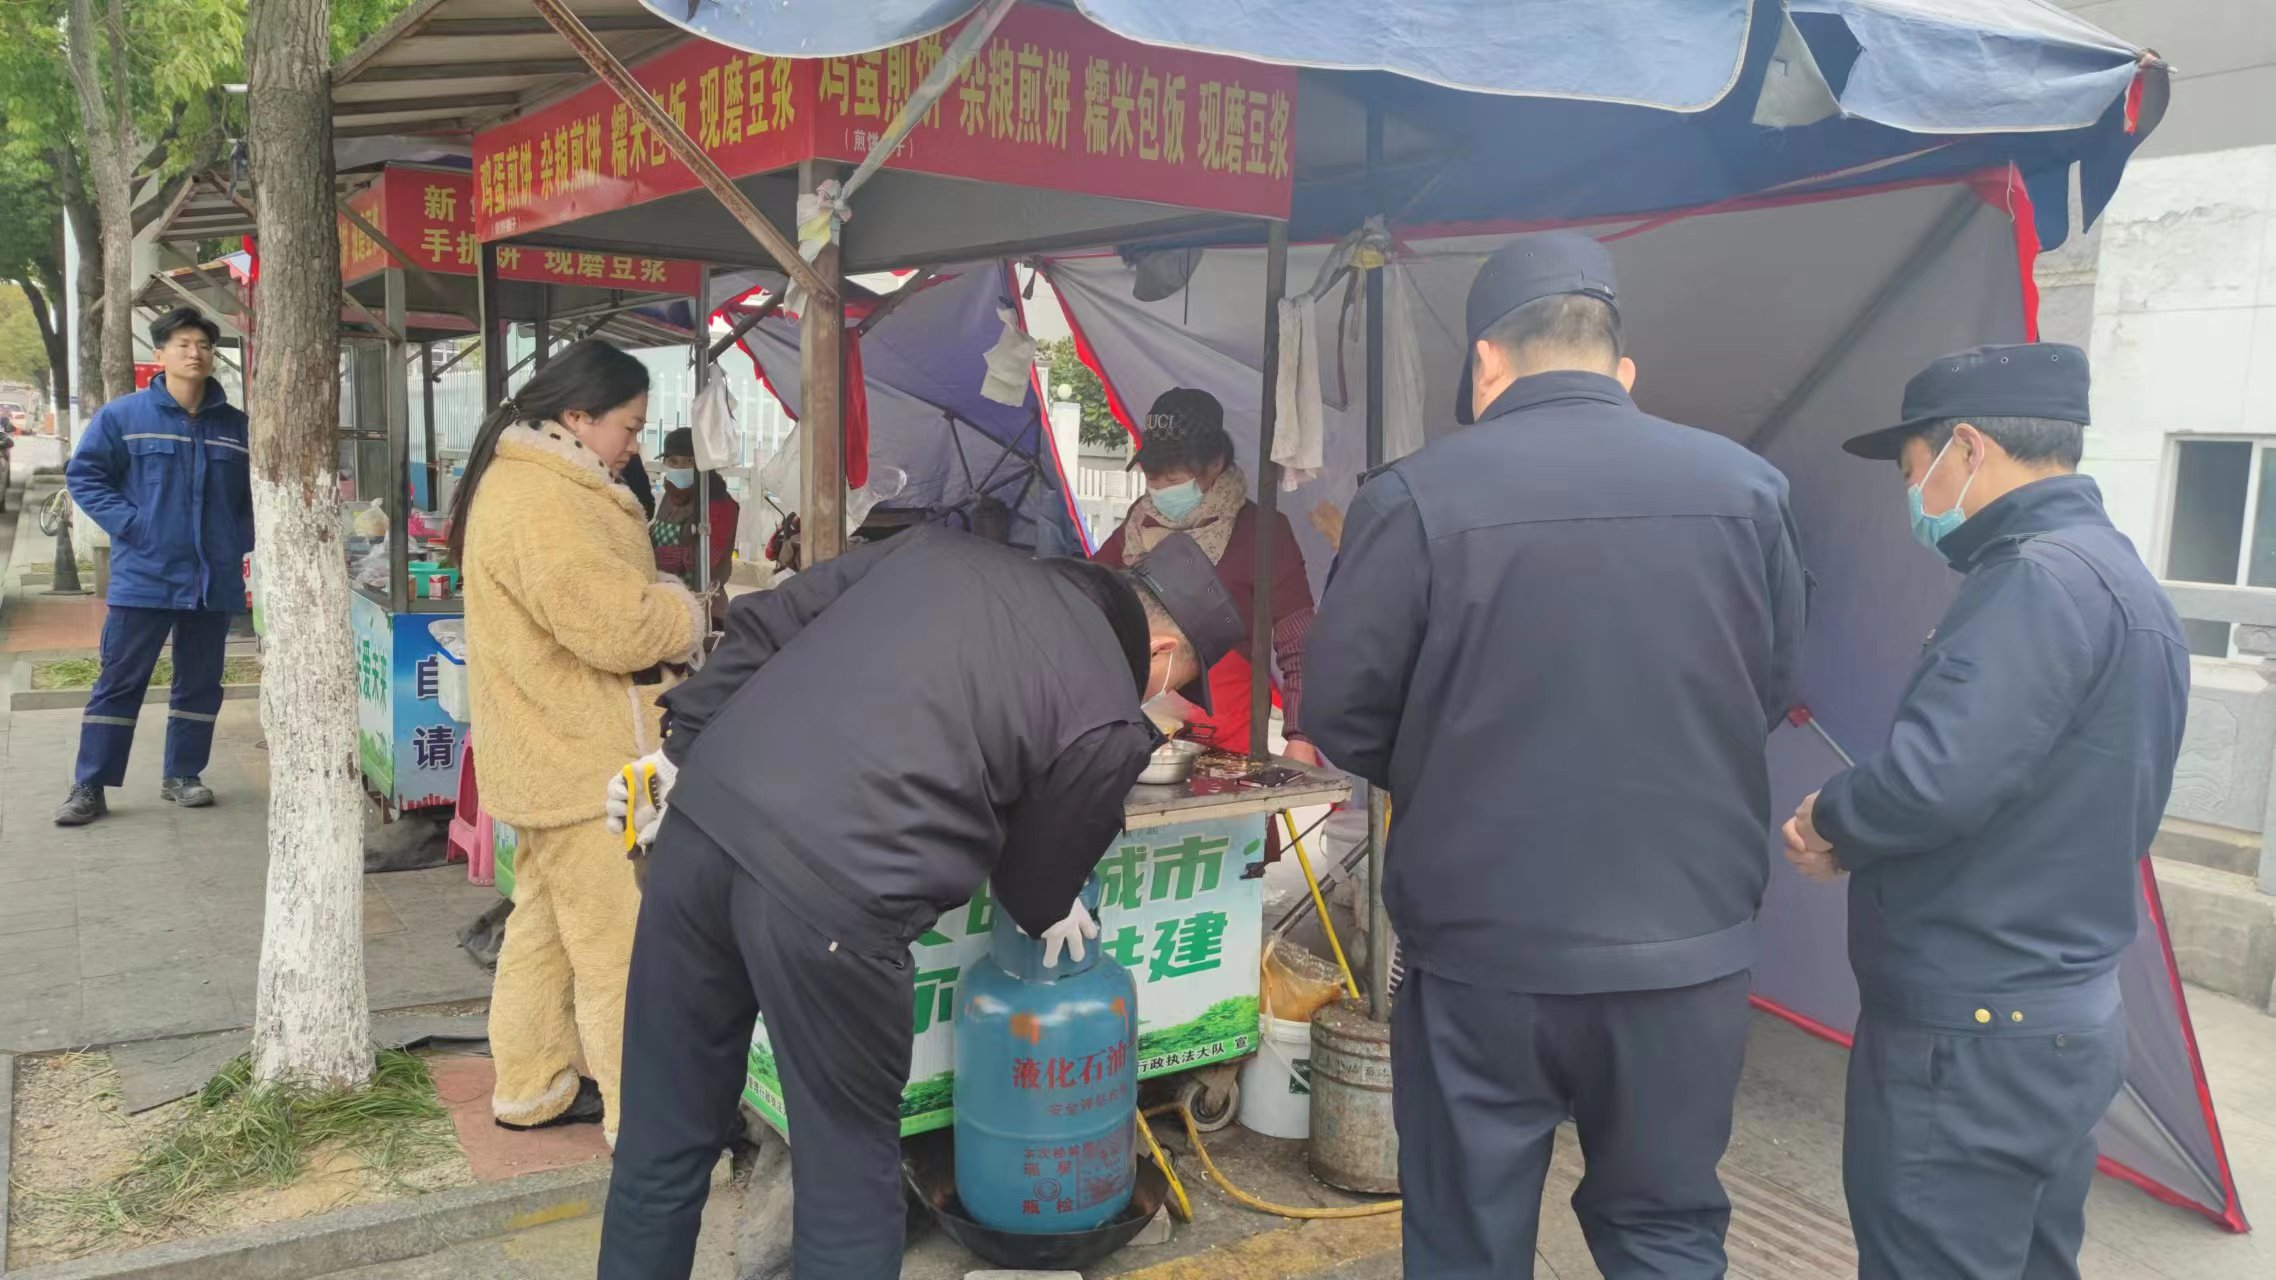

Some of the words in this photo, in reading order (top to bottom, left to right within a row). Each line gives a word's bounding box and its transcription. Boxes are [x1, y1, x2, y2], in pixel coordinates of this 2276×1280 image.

[959, 36, 1072, 149] 杂粮煎饼
[1084, 56, 1186, 165] 糯米包饭
[1198, 80, 1290, 180] 现磨豆浆
[480, 139, 533, 217] 鸡蛋煎饼
[541, 111, 601, 200] 杂粮煎饼
[699, 54, 795, 152] 现磨豆浆
[544, 249, 668, 283] 现磨豆浆
[413, 725, 455, 768] 请
[1012, 1035, 1134, 1089] 液化石油
[1234, 1036, 1248, 1050] 宣
